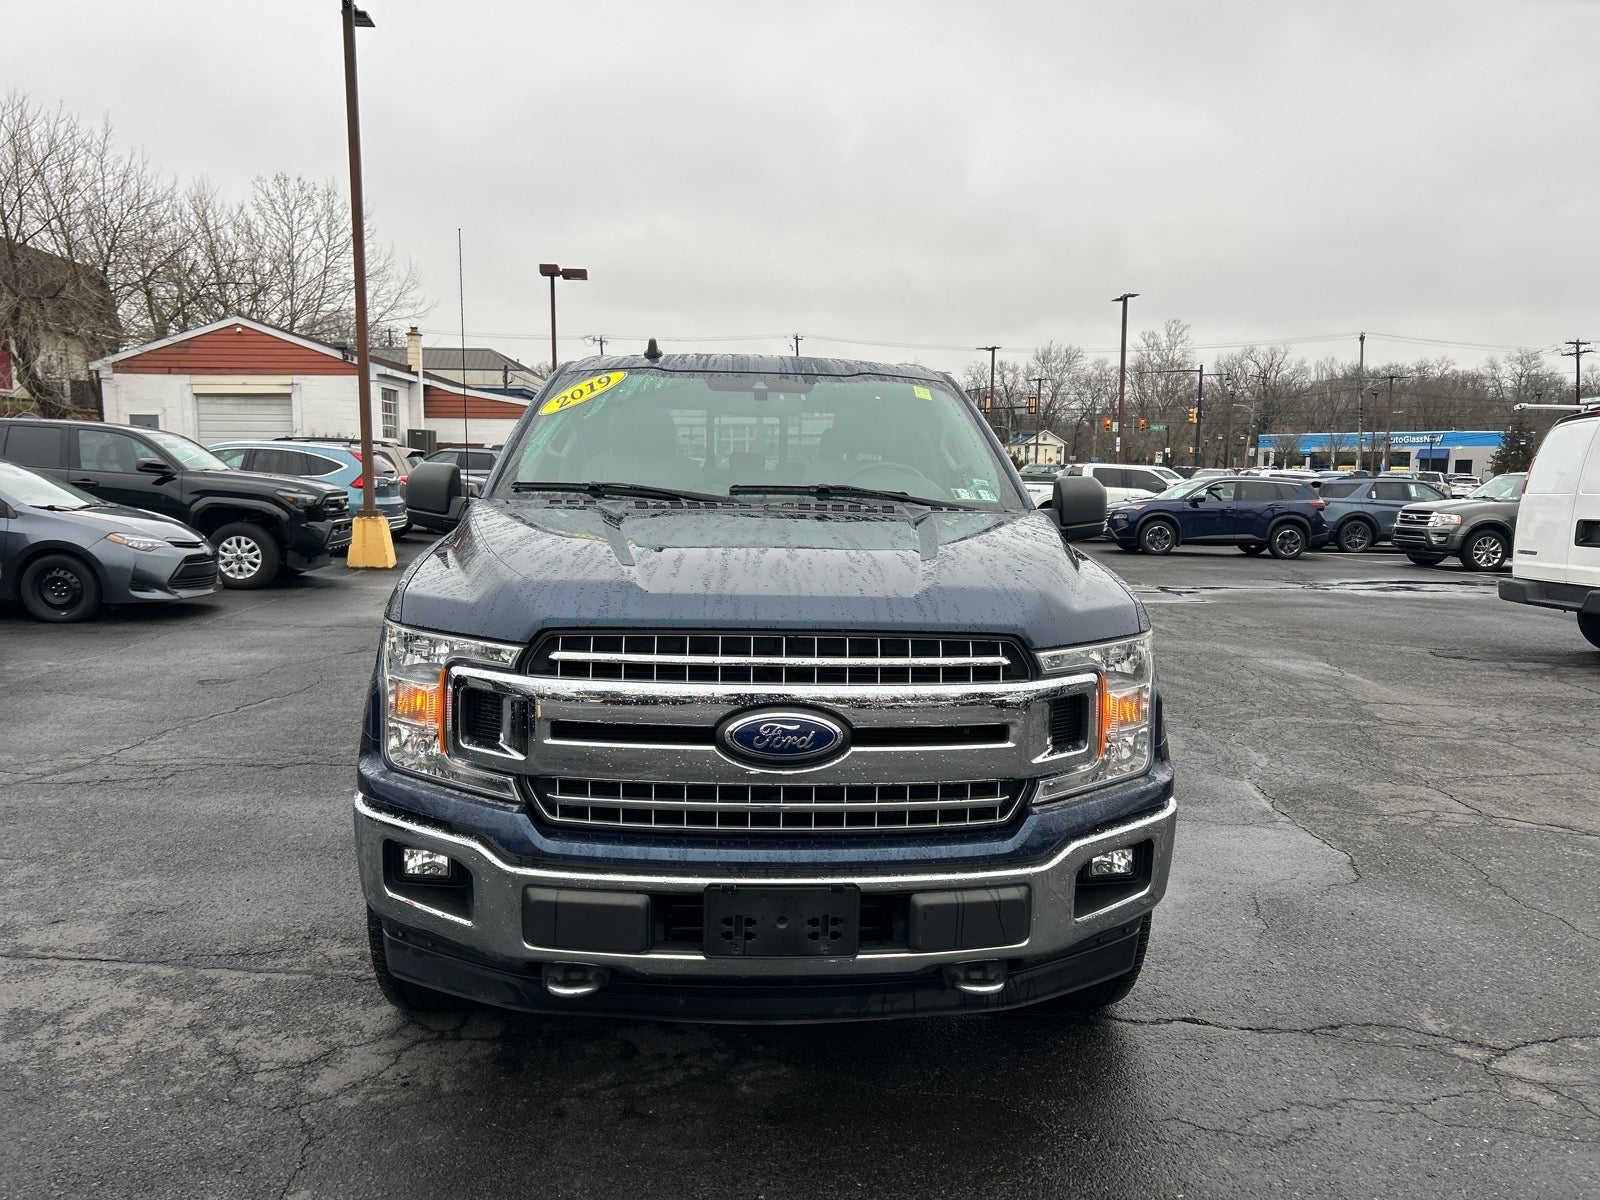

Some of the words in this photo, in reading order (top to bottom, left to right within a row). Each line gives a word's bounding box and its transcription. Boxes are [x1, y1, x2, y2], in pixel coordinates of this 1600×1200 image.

[556, 375, 612, 409] 2019
[1387, 433, 1444, 445] utoGlassNw
[752, 722, 816, 750] Ford
